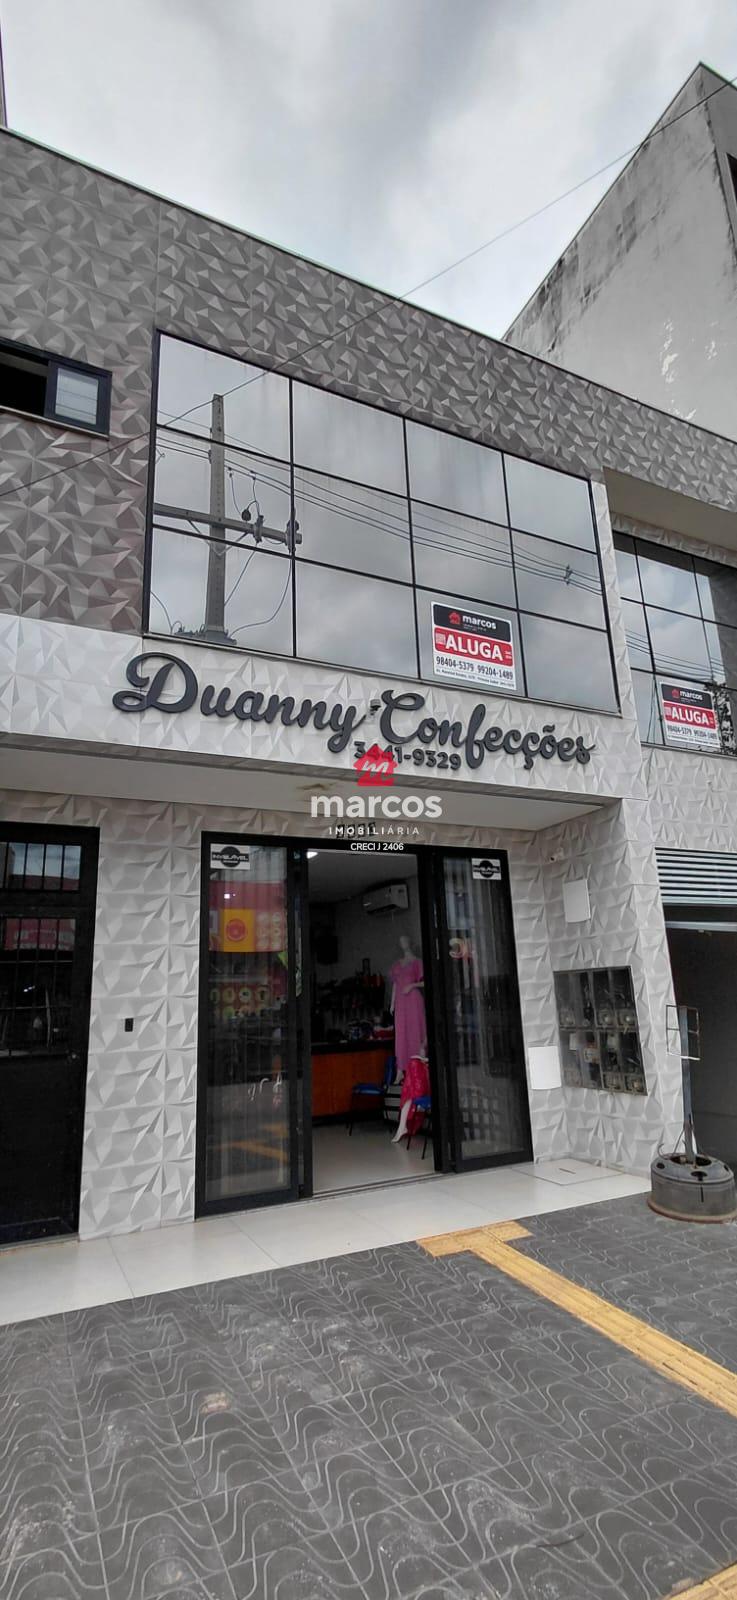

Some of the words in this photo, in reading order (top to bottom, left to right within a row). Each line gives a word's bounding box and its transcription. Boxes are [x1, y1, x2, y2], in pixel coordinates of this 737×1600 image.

[462, 615, 497, 630] marcos
[445, 634, 503, 661] ALUGA
[436, 656, 474, 672] 98404-5379
[477, 664, 513, 680] 99204-1489
[112, 652, 367, 753] Duanny
[379, 689, 595, 770] Confecções
[671, 706, 709, 726] ALUGA
